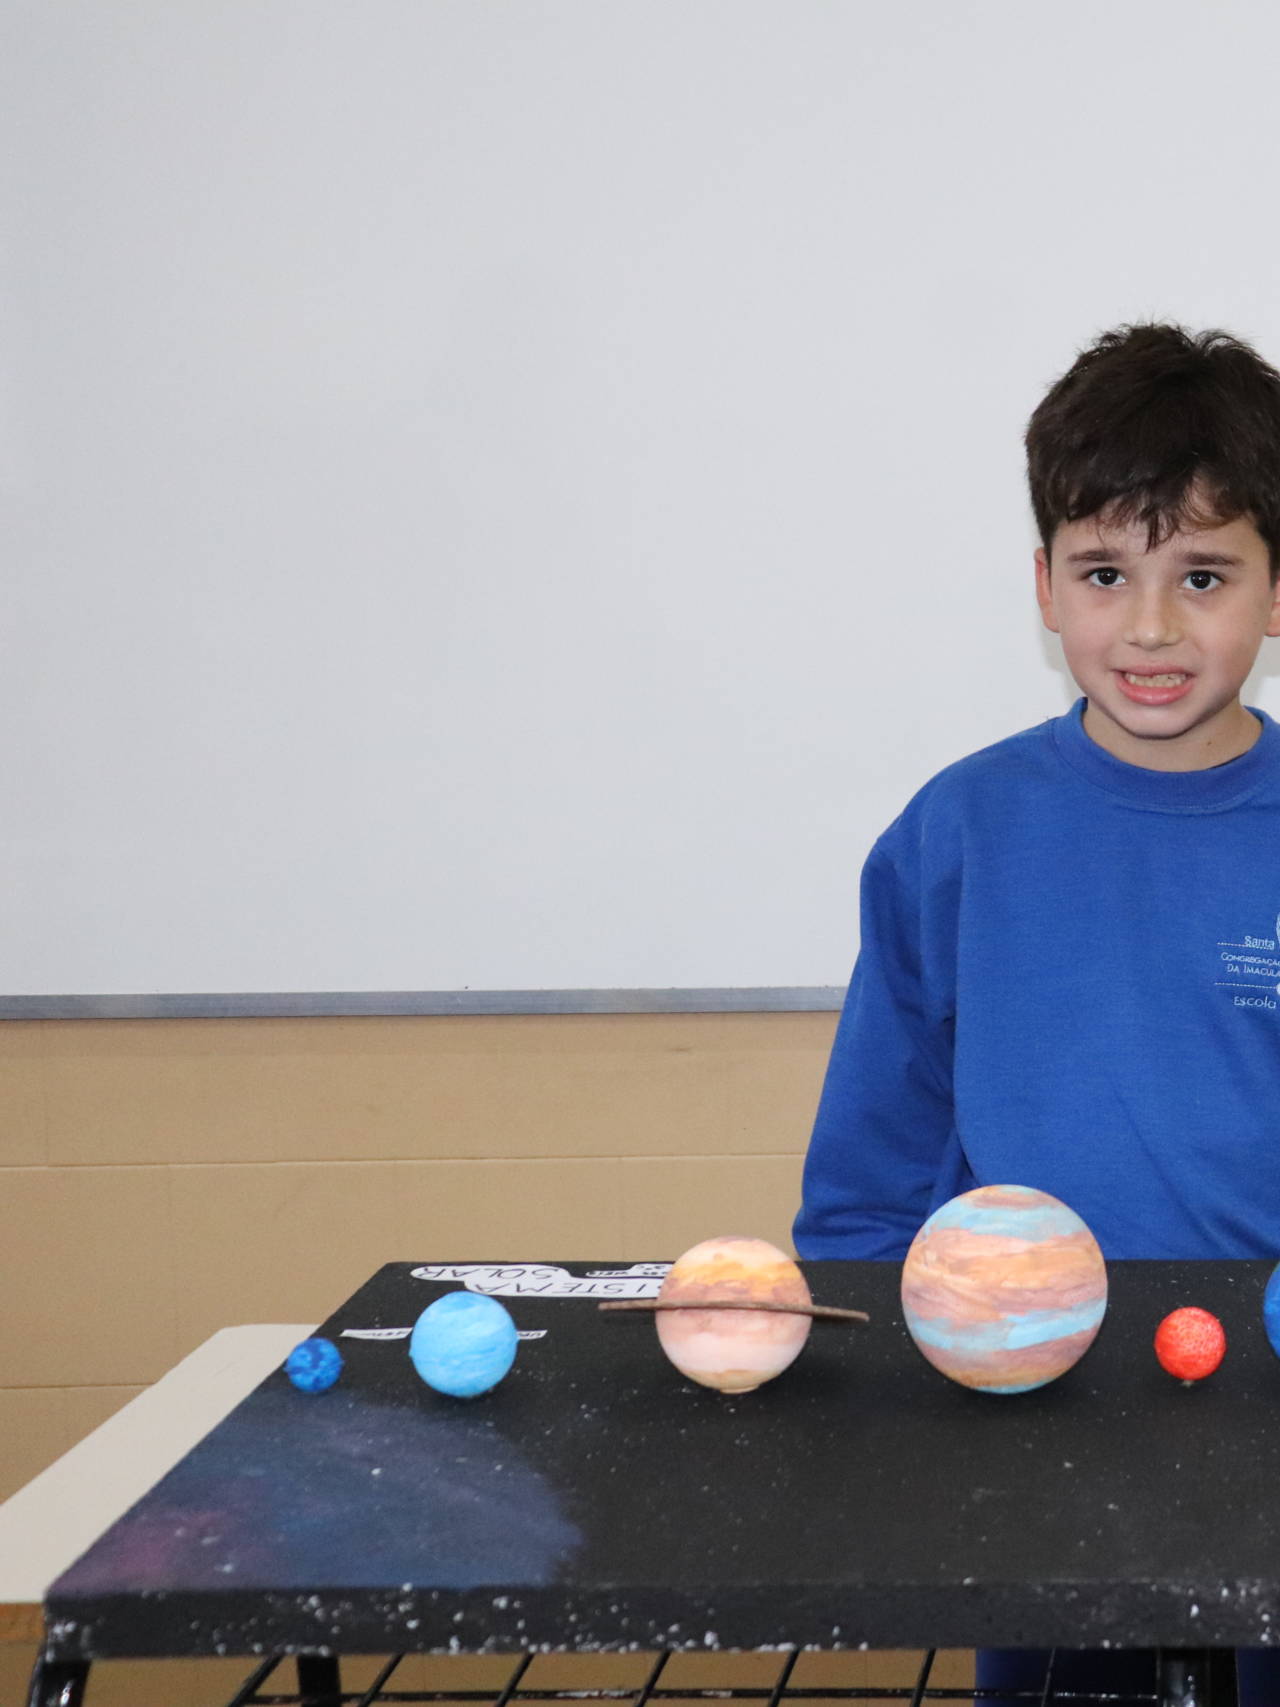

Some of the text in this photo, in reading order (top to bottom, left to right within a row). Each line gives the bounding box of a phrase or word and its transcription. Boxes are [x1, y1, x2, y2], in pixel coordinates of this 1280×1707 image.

[1244, 935, 1275, 950] Santa
[1227, 963, 1240, 974] DA
[1233, 995, 1277, 1010] Escola
[417, 1267, 560, 1280] SOLAR
[474, 1281, 662, 1295] ISTEMA
